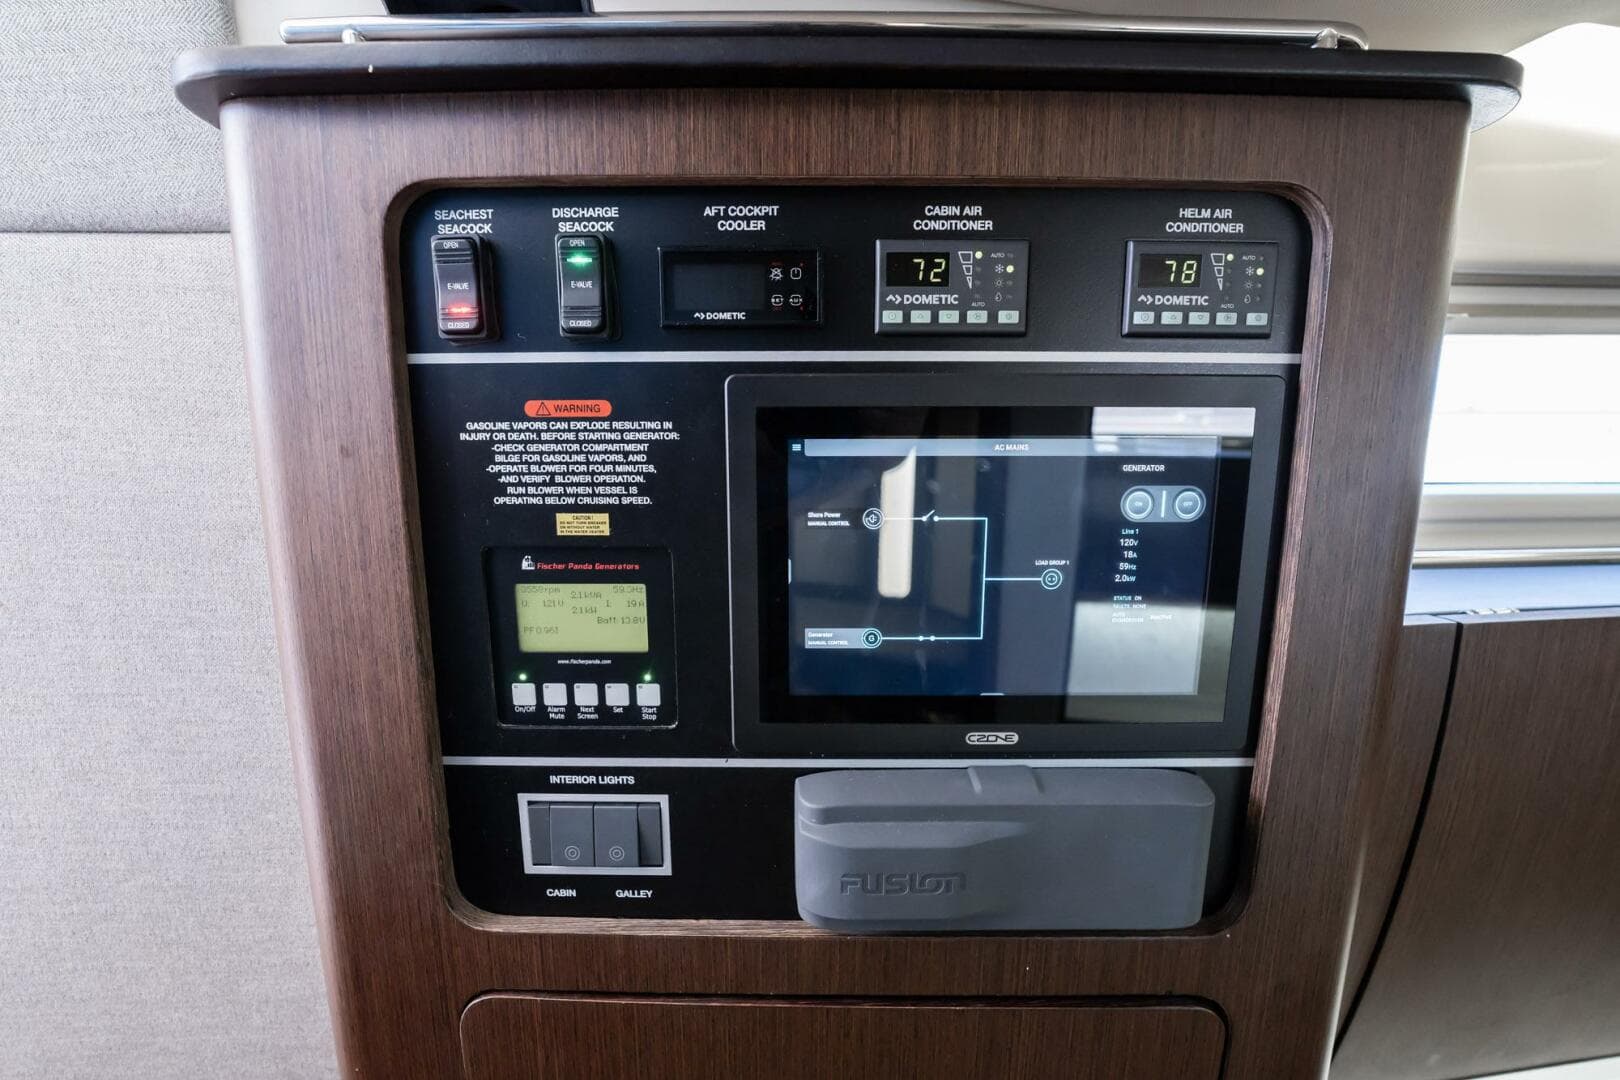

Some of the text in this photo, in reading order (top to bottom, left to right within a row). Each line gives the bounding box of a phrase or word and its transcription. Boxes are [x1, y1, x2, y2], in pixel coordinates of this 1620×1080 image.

[434, 209, 494, 220] SEACHEST
[552, 207, 619, 218] DISCHARGE
[703, 206, 779, 216] AFT COCKPIT
[924, 205, 982, 216] CABIN AIR
[1179, 208, 1233, 219] HELM AIR
[437, 223, 493, 234] SEACOCK
[558, 221, 614, 232] SEACOCK
[717, 220, 766, 231] COOLER
[913, 220, 993, 231] CONDITIONER
[1165, 222, 1244, 233] CONDITIONER
[912, 258, 946, 282] 72
[1165, 260, 1198, 284] 78
[447, 282, 469, 290] E-VALVE
[570, 280, 593, 288] E-VALVE
[903, 294, 959, 305] DOMETIC
[1154, 295, 1209, 306] DOMETIC
[706, 312, 746, 320] DOMETIC
[448, 321, 470, 329] CLOSED
[569, 319, 592, 327] CLOSED
[553, 404, 601, 413] WARNING
[466, 421, 673, 430] GASOLINE VAPORS CAN EXPLODE RESULTING IN
[459, 432, 681, 440] INJURY OR DEATH. BEFORE STARTING GENERATOR:
[491, 443, 649, 452] -CHECK GENERATOR COMPARTMENT
[495, 454, 647, 463] BILGE FOR GASOLINE VAPORS, AND
[486, 465, 657, 474] -OPERATE BLOWER FOR FOUR MINUTES,
[1122, 464, 1166, 472] GENERATOR
[498, 475, 646, 483] -AND VERIFY BLOWER OPERATION.
[507, 486, 638, 494] RUN BLOWER WHEN VESSEL IS
[493, 497, 653, 505] OPERATING BELOW CRUISING SPEED.
[1115, 574, 1136, 582] 2.0kW
[967, 734, 1016, 743] CZONE
[549, 775, 635, 784] INTERIOR LIGHTS
[840, 871, 967, 896] FUSION
[546, 889, 576, 897] CABIN
[615, 890, 653, 898] GALLEY
